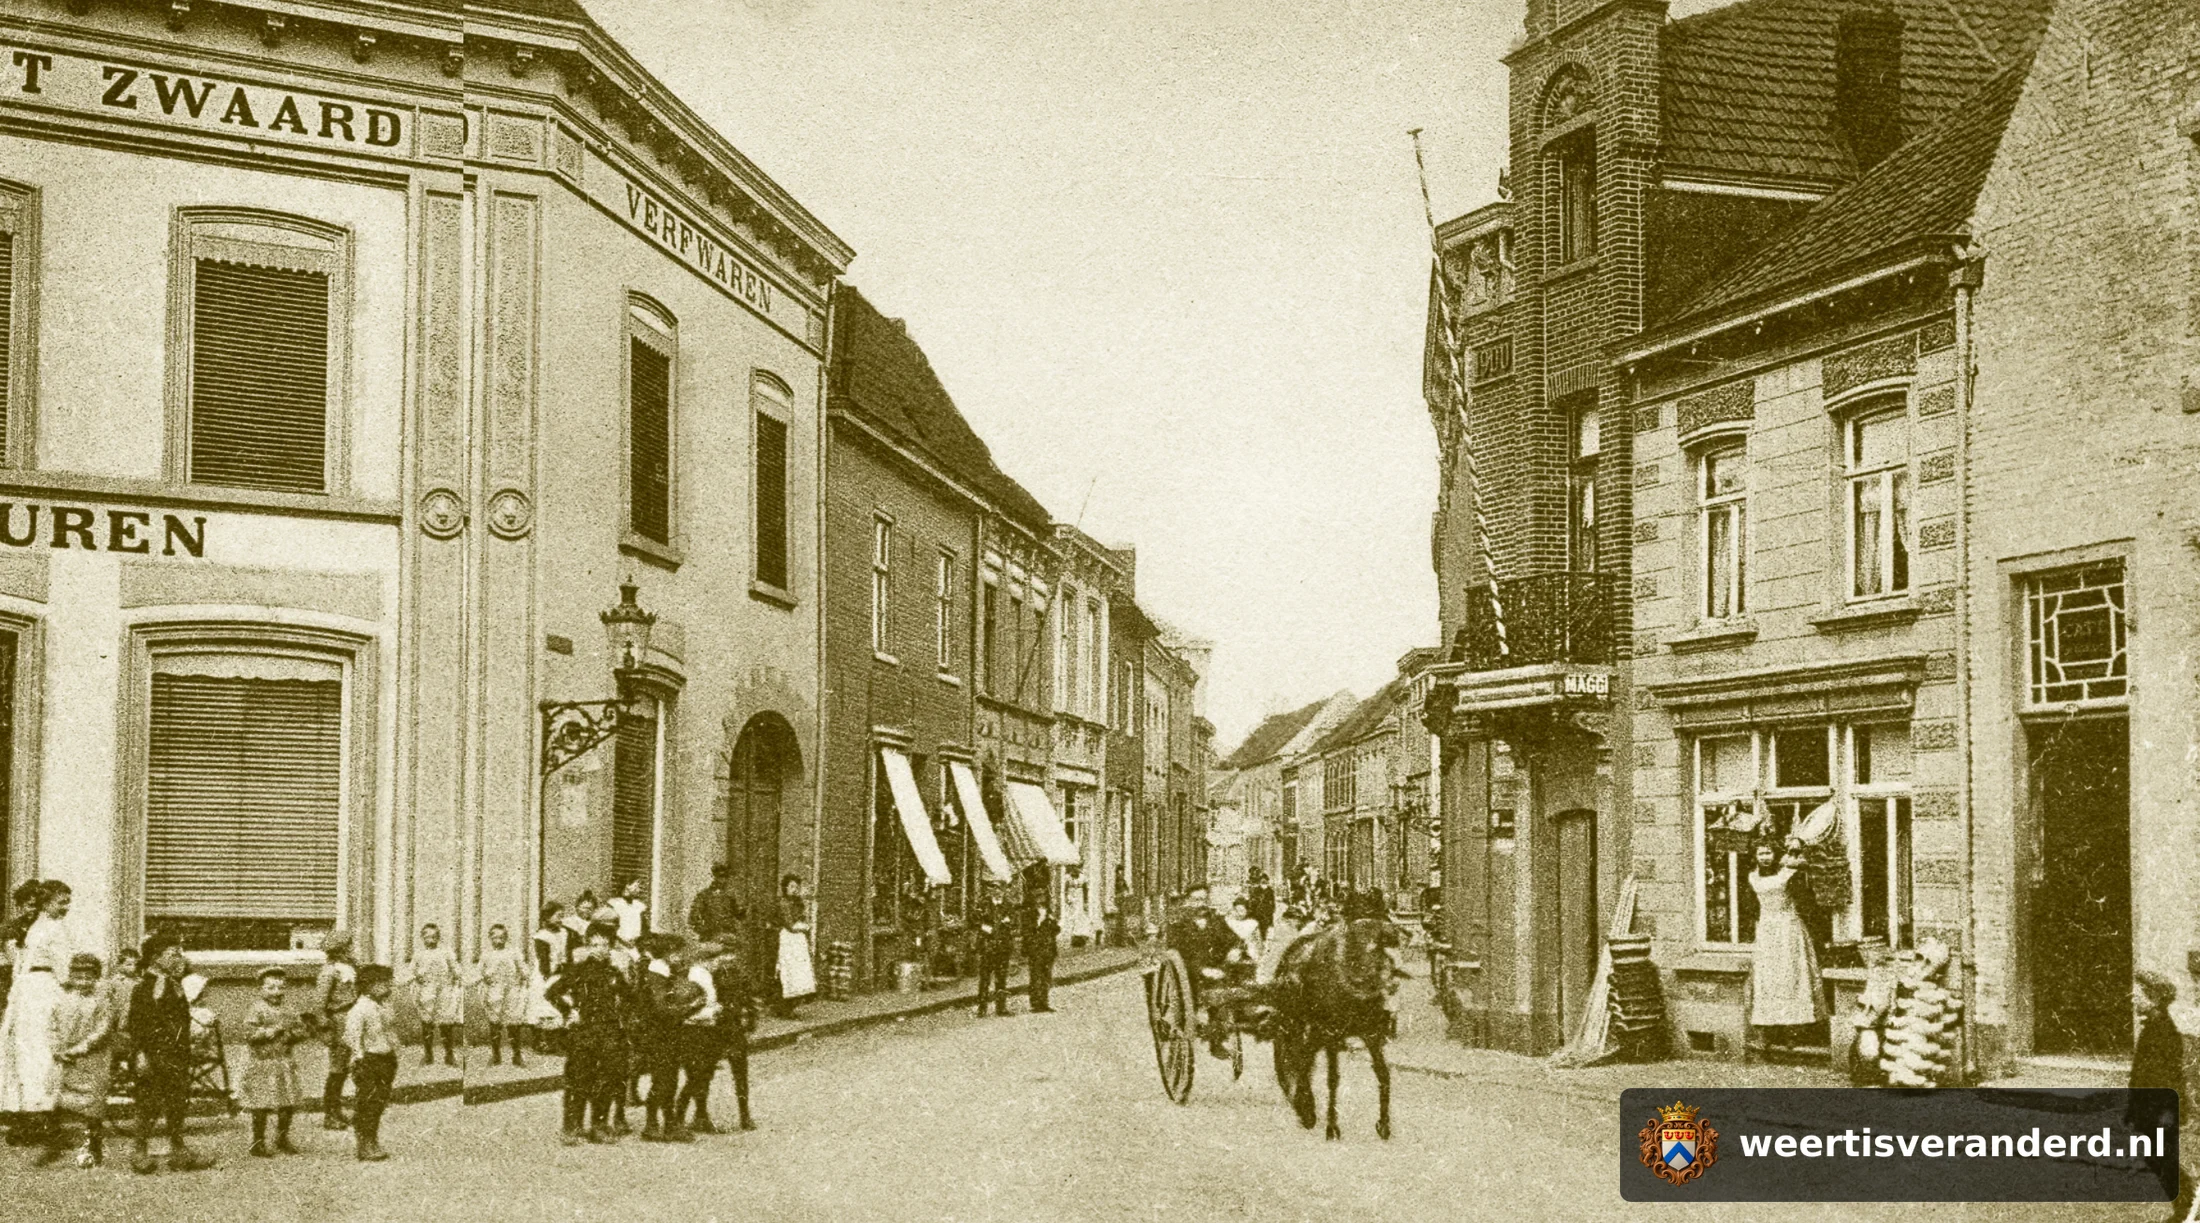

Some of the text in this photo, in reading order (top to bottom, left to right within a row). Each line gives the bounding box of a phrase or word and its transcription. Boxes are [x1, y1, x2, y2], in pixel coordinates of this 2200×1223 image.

[13, 50, 402, 147] T ZWAARD
[626, 182, 772, 313] VERFWAREN
[1563, 673, 1609, 693] MAGGI
